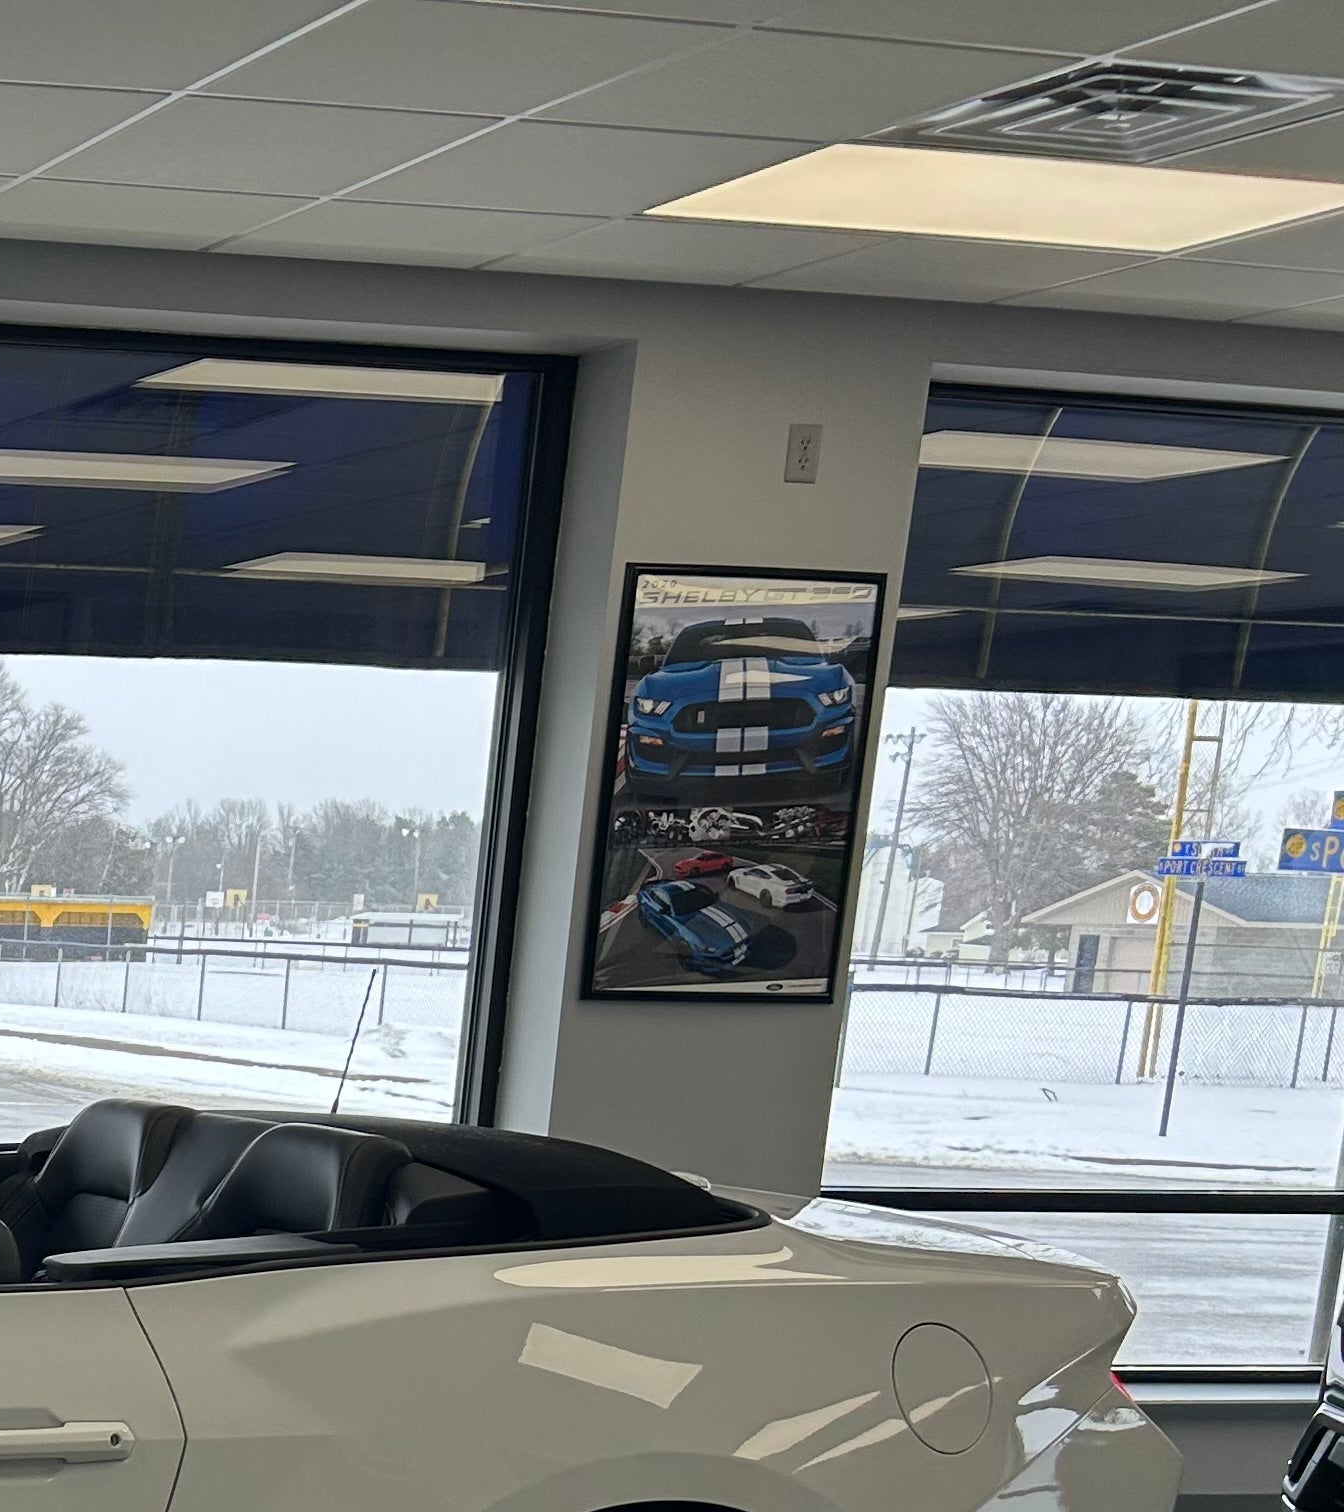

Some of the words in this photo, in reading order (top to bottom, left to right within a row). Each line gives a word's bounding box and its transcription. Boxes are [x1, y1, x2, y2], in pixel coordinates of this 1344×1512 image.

[639, 588, 762, 605] SHELBY
[1163, 860, 1189, 874] PORT
[1190, 861, 1237, 876] CRESCENT
